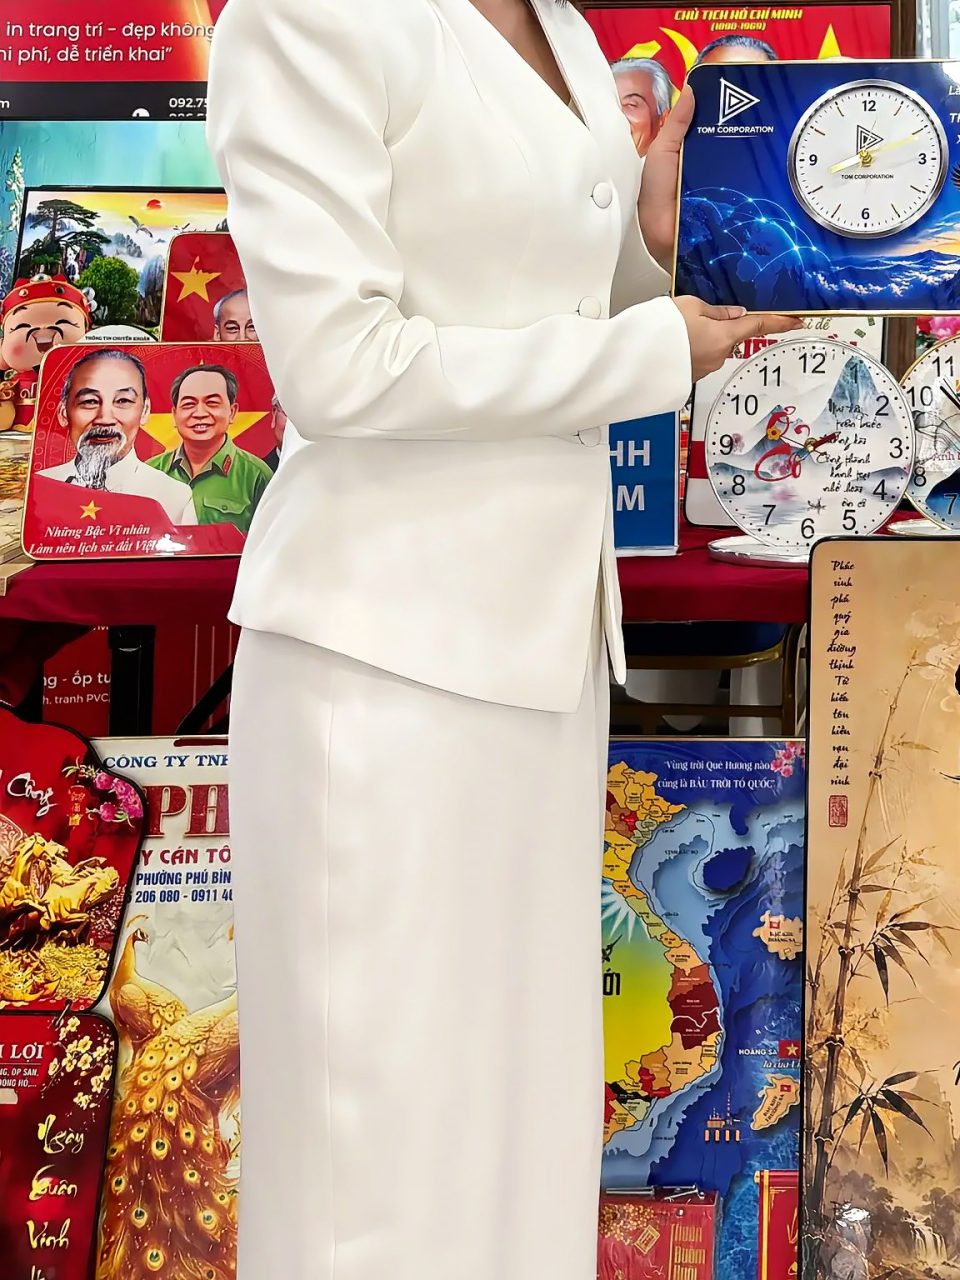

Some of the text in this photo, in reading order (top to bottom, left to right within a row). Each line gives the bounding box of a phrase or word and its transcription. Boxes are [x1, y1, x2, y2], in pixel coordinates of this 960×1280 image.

[770, 9, 803, 20] MINH
[6, 21, 23, 37] in
[29, 22, 80, 42] trang
[85, 21, 104, 37] trí
[122, 22, 156, 41] đẹp
[18, 46, 52, 66] phí,
[57, 43, 80, 62] dễ
[85, 44, 124, 62] triển
[862, 100, 877, 112] 12
[697, 125, 774, 134] TOM CORPORATION
[808, 153, 818, 166] 9
[918, 153, 927, 165] 3
[861, 208, 870, 220] 6
[798, 352, 826, 374] 12
[850, 362, 859, 384] 1
[932, 356, 955, 377] 11
[758, 365, 781, 387] 11
[731, 394, 759, 416] 10
[874, 394, 889, 416] 2
[906, 385, 933, 407] 10
[719, 433, 733, 456] 9
[889, 437, 904, 459] 3
[731, 474, 746, 495] 8
[914, 466, 927, 487] 8
[872, 478, 887, 500] 4
[762, 504, 777, 525] 7
[943, 493, 958, 515] 7
[801, 517, 815, 539] 6
[842, 509, 857, 531] 5
[44, 525, 81, 539] Những
[84, 524, 106, 539] Bậc
[122, 524, 150, 536] nhân
[29, 542, 53, 555] Làm
[55, 541, 76, 553] nên
[77, 541, 98, 555] lịch
[100, 542, 114, 552] sử
[115, 538, 133, 552] đất
[833, 626, 850, 640] gia
[72, 669, 92, 688] ốp
[54, 694, 84, 705] tranh
[104, 754, 158, 769] CÔNG
[164, 755, 189, 767] TY
[679, 778, 688, 788] là
[159, 845, 199, 866] CÁN
[136, 870, 182, 886] PHƯỜNG
[185, 869, 208, 885] PHÚ
[135, 890, 156, 903] 206
[159, 890, 180, 903] 080
[191, 888, 218, 902] 0911
[10, 1041, 45, 1062] LỢI
